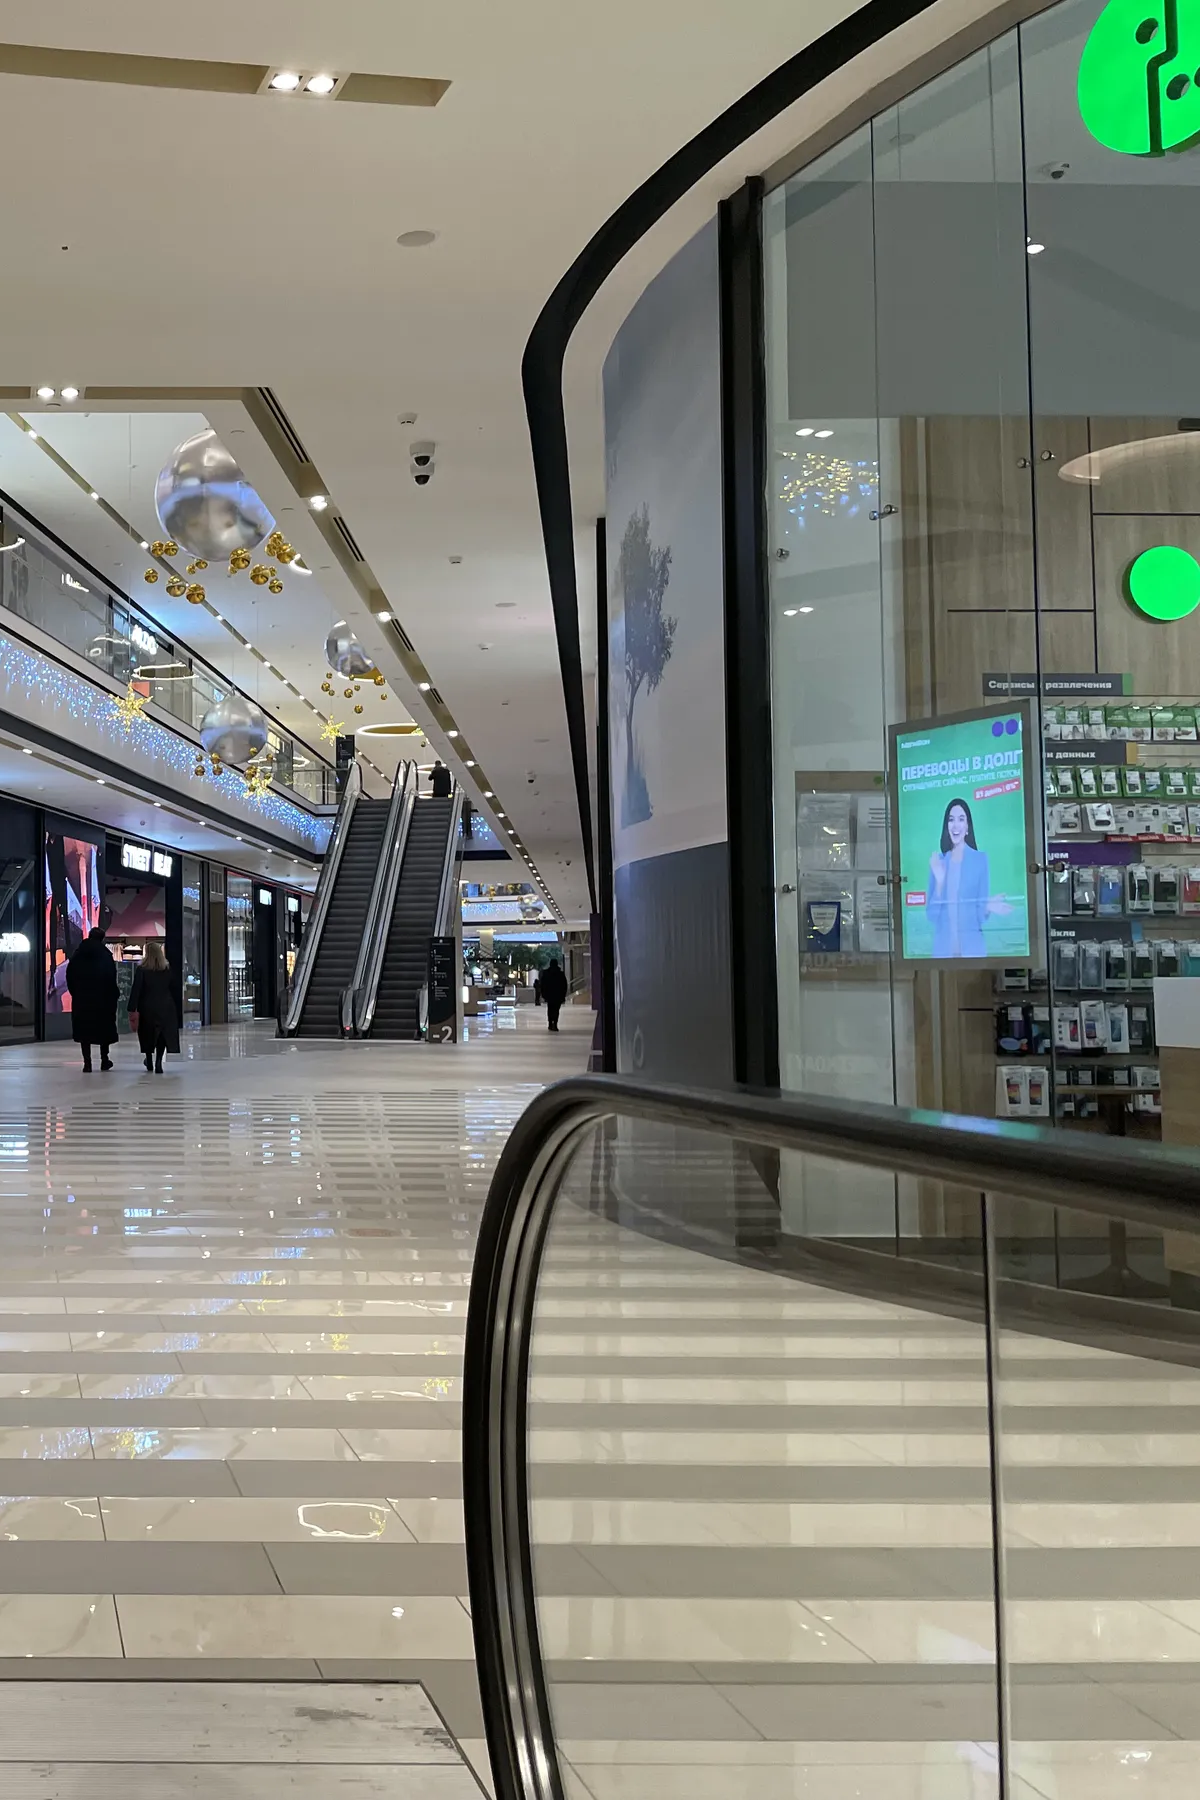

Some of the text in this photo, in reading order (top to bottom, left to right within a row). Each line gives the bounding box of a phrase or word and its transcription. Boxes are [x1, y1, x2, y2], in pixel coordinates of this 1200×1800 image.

[988, 680, 1112, 691] Сервисы развлечения
[1056, 751, 1096, 759] данных
[902, 750, 1022, 781] ПЕРЕВОДЫ В ДОЛГ
